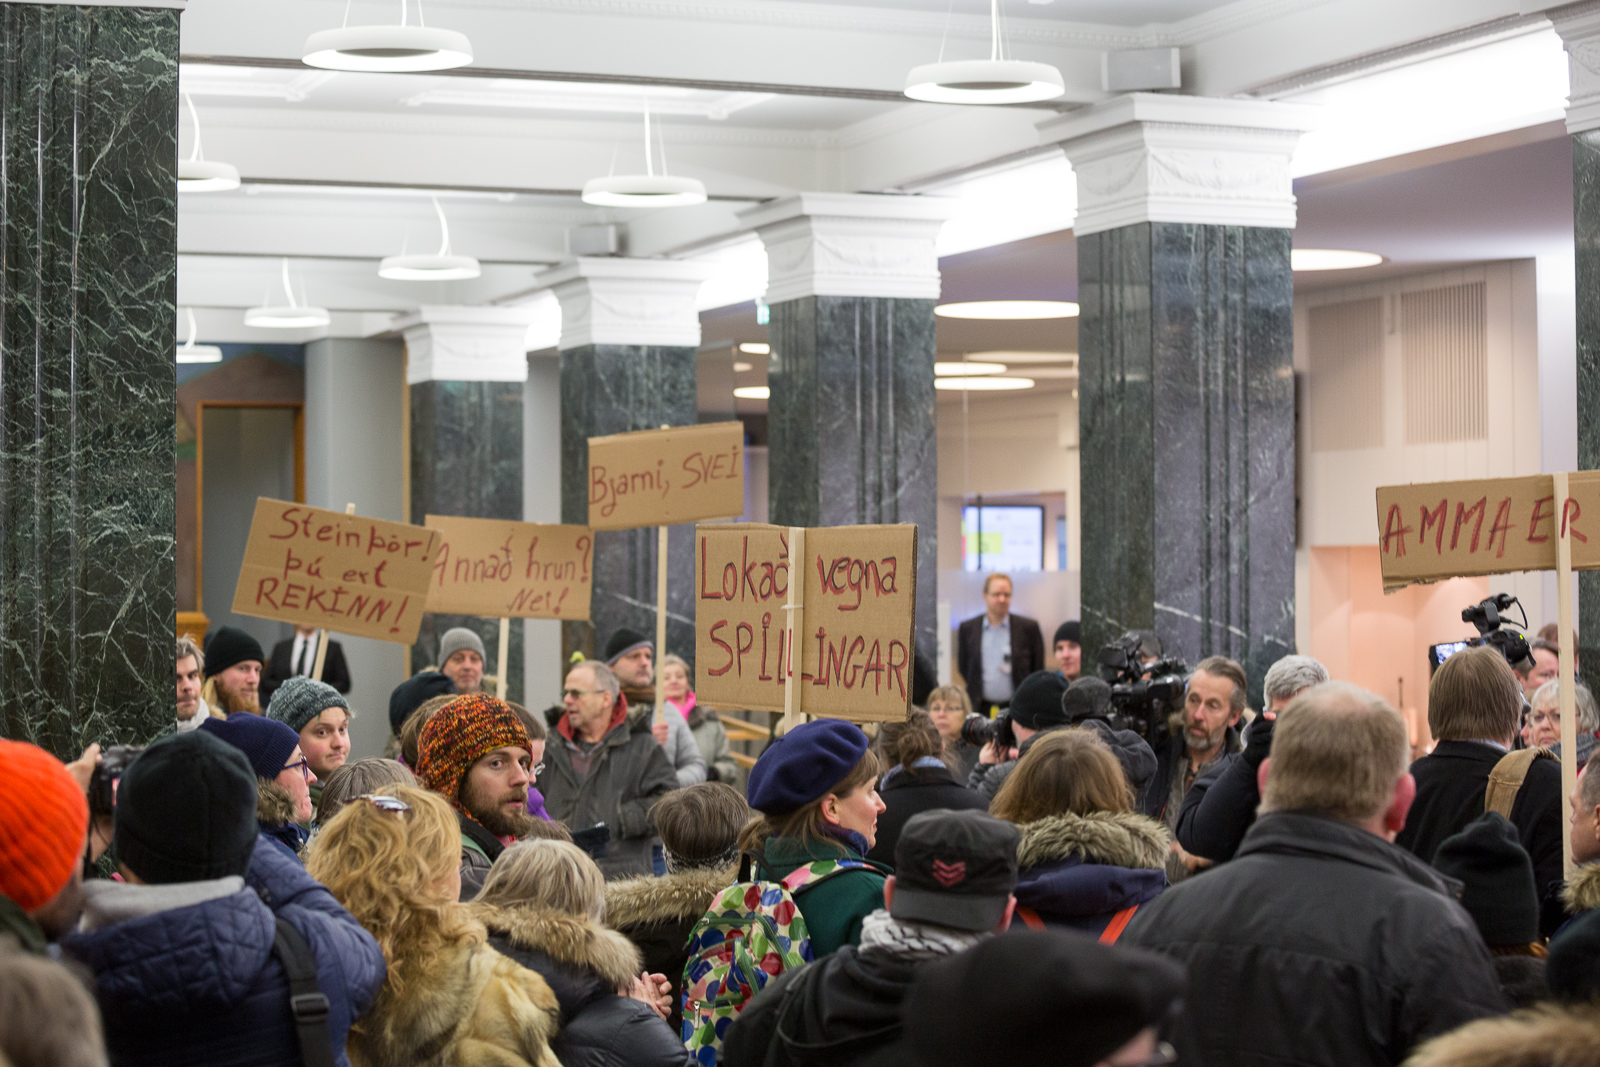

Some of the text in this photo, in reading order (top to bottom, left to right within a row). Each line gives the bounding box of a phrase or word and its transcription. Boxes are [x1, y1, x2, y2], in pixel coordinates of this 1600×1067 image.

[588, 444, 740, 518] Bjarni, SVEI
[283, 547, 388, 589] þú ert
[433, 534, 592, 587] Annað hrun?
[700, 532, 899, 612] Lokað vegna
[254, 576, 411, 634] REKINN!
[507, 586, 570, 615] Nei!
